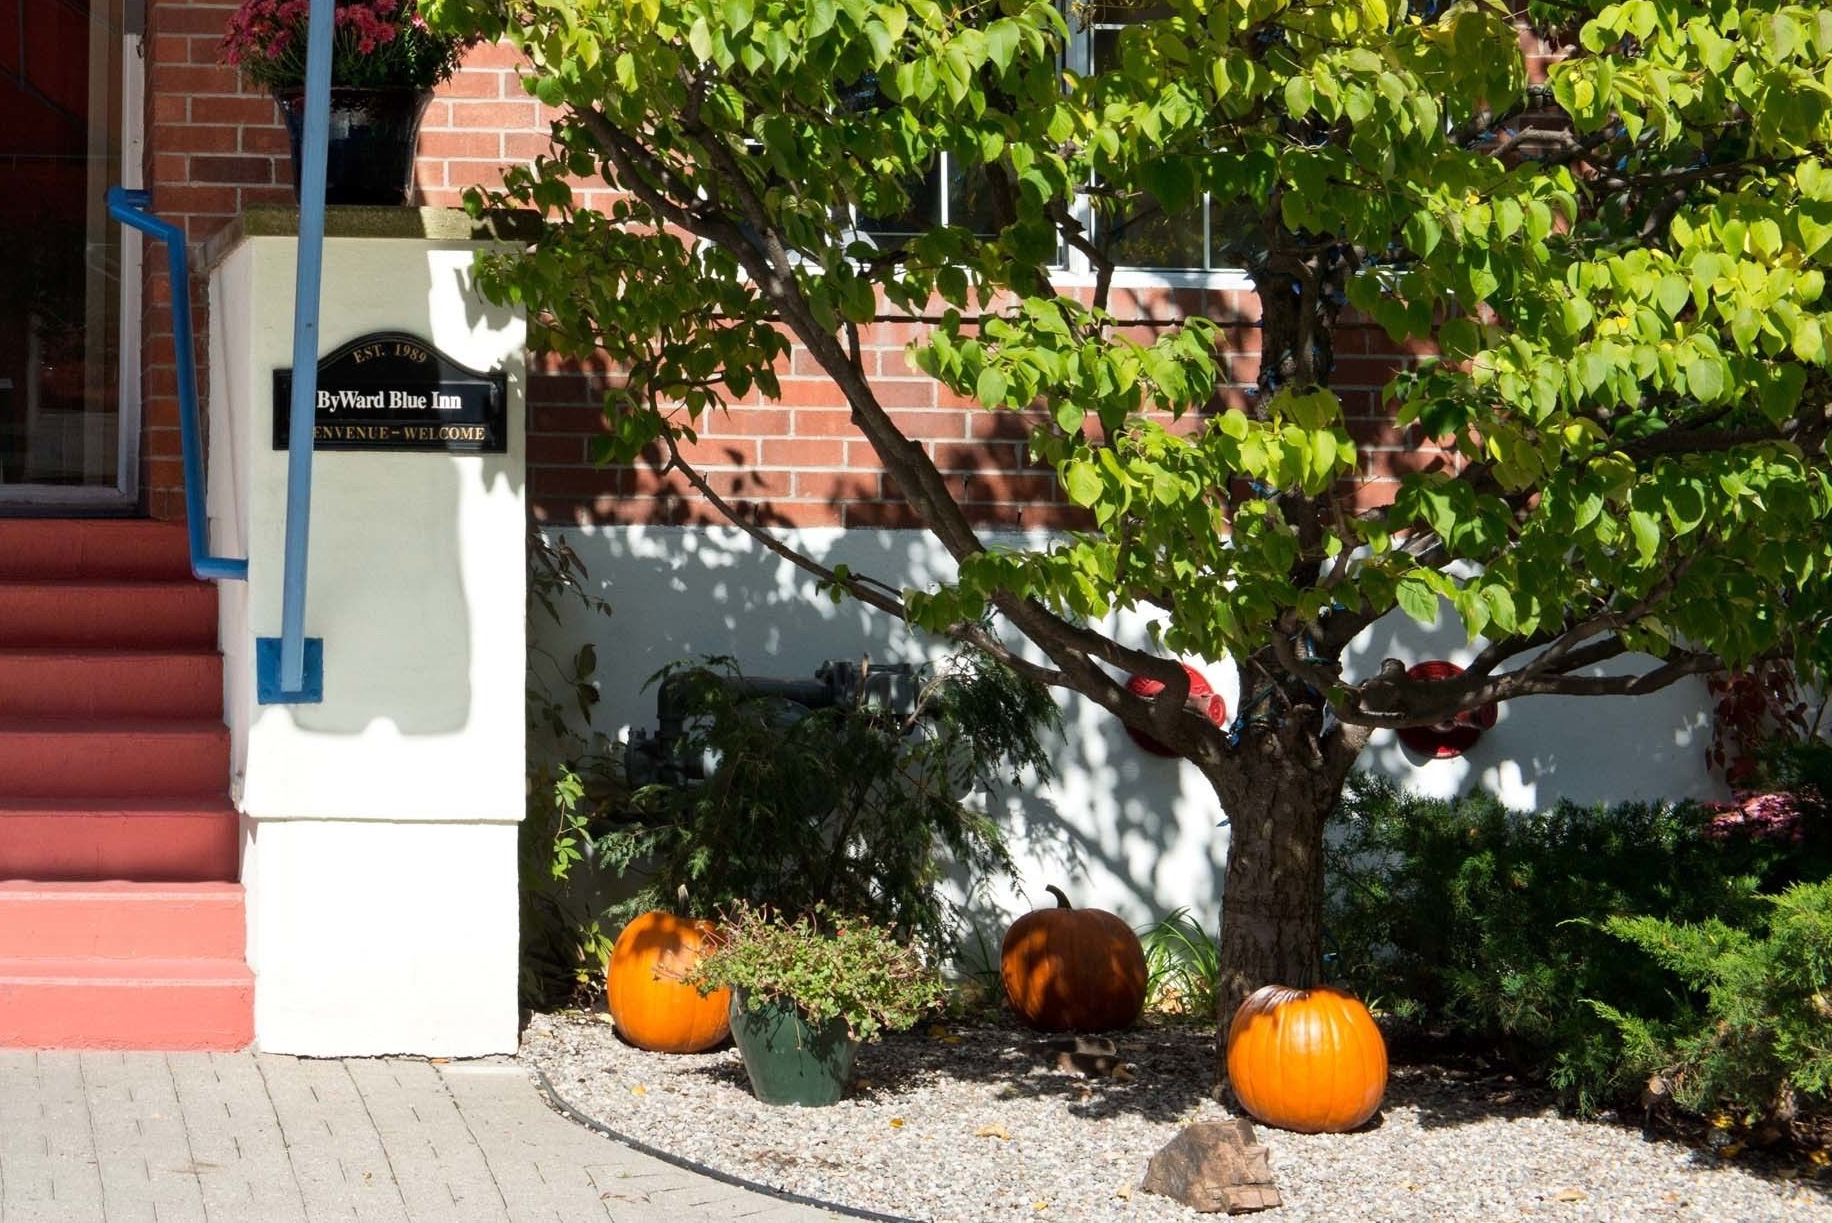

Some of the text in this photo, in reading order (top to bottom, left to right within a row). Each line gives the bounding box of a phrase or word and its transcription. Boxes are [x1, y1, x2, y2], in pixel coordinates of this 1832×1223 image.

[353, 344, 427, 363] EST. 1989
[316, 390, 462, 412] ByWard Blue Inn
